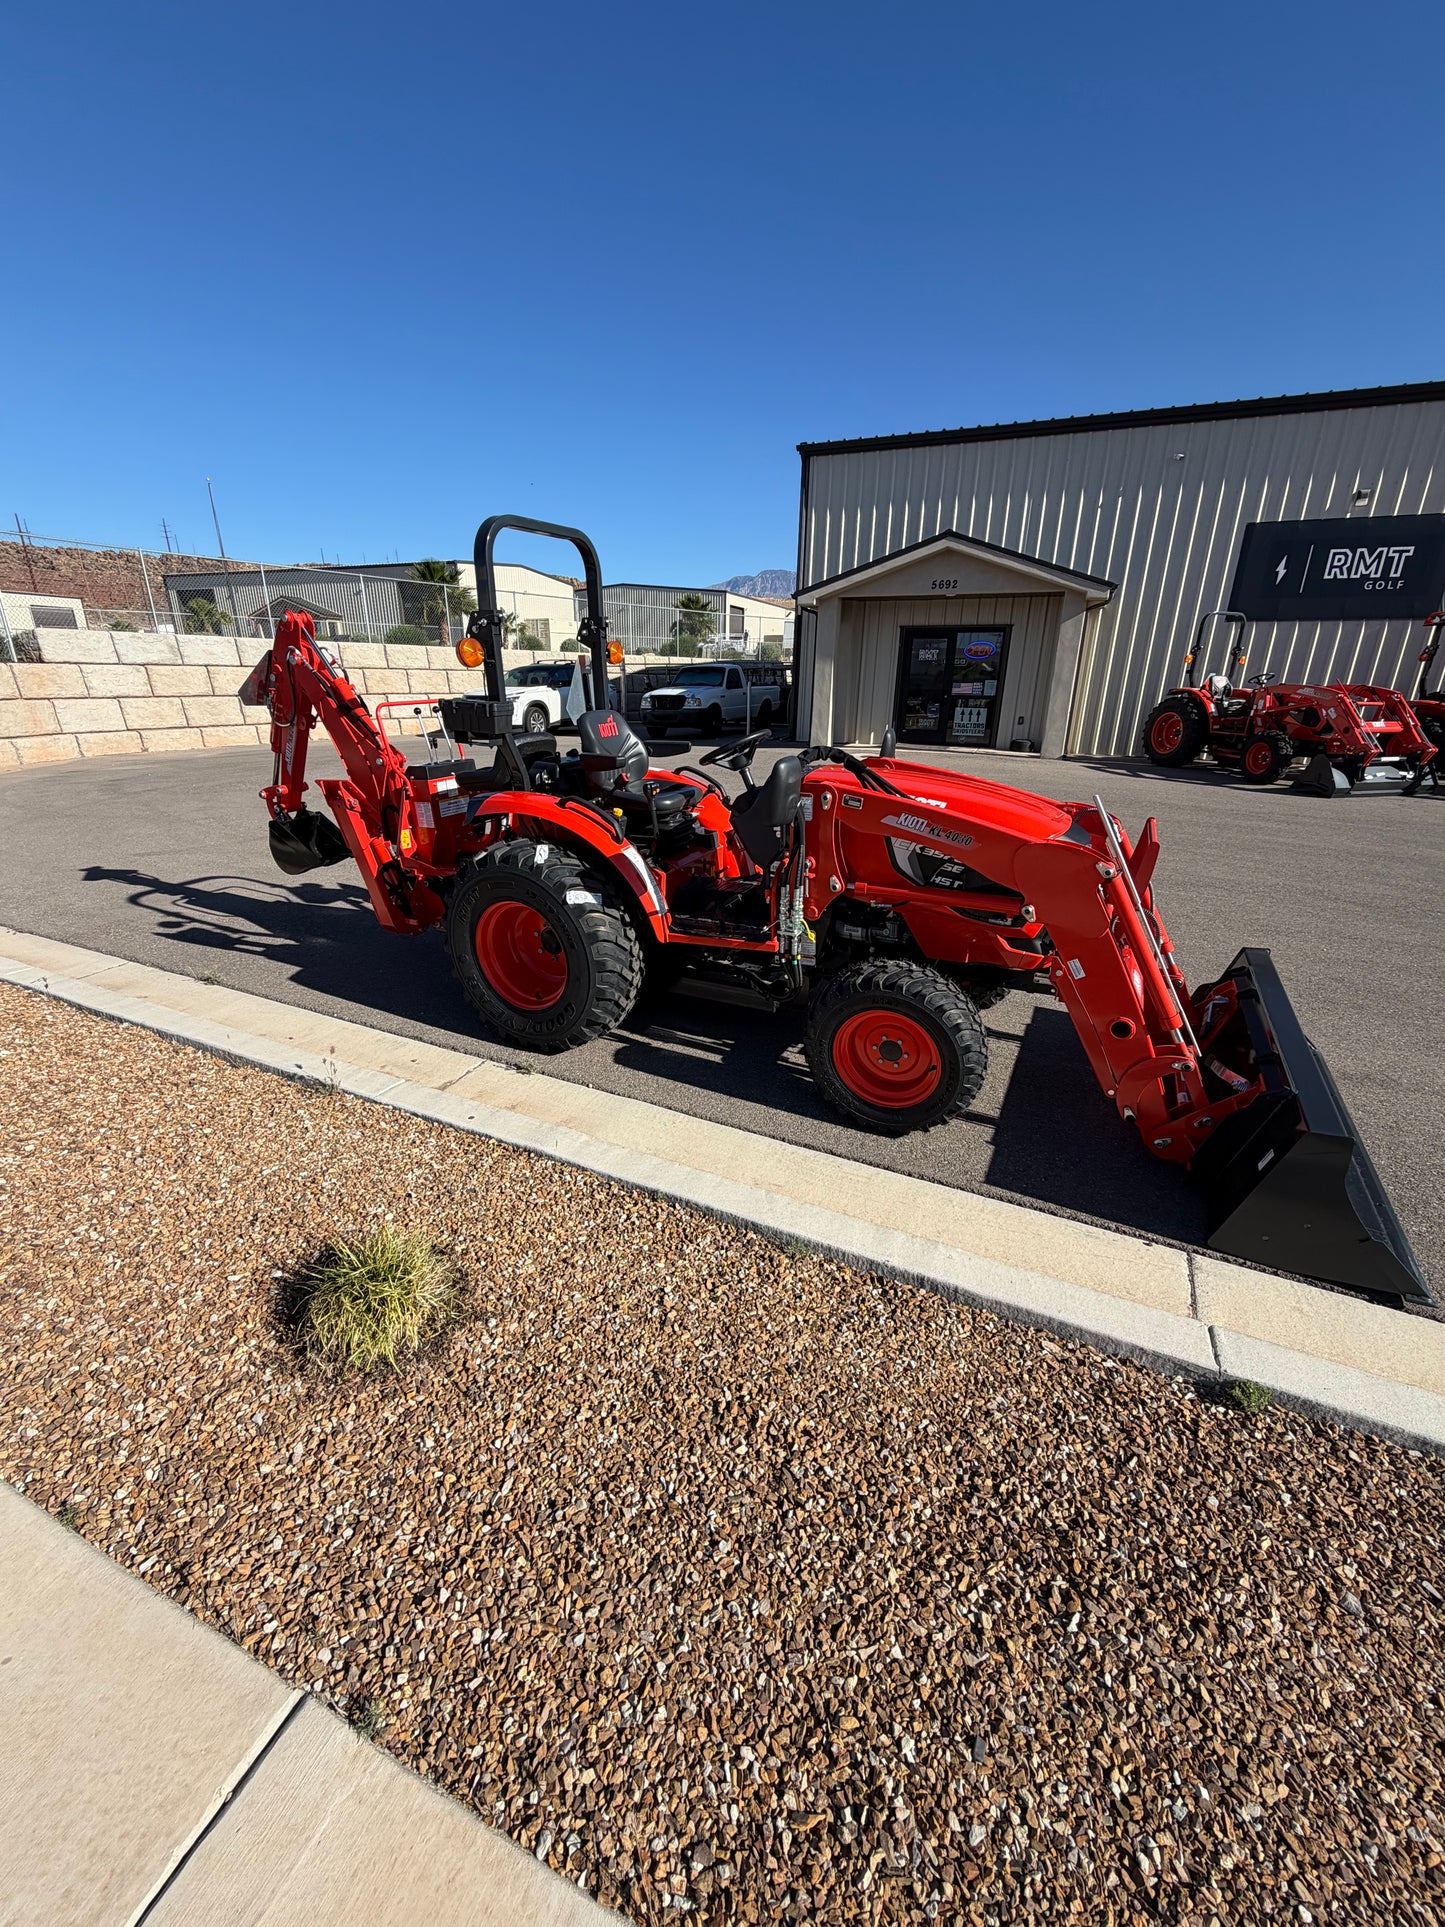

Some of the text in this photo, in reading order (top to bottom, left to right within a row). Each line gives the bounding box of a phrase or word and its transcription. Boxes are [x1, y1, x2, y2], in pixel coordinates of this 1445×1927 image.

[1323, 546, 1415, 580] RMT
[931, 579, 958, 590] 5692
[1364, 580, 1405, 590] GOLF
[965, 645, 993, 656] OPEN
[897, 812, 973, 847] KIOTI KL 4030
[940, 862, 965, 874] SE
